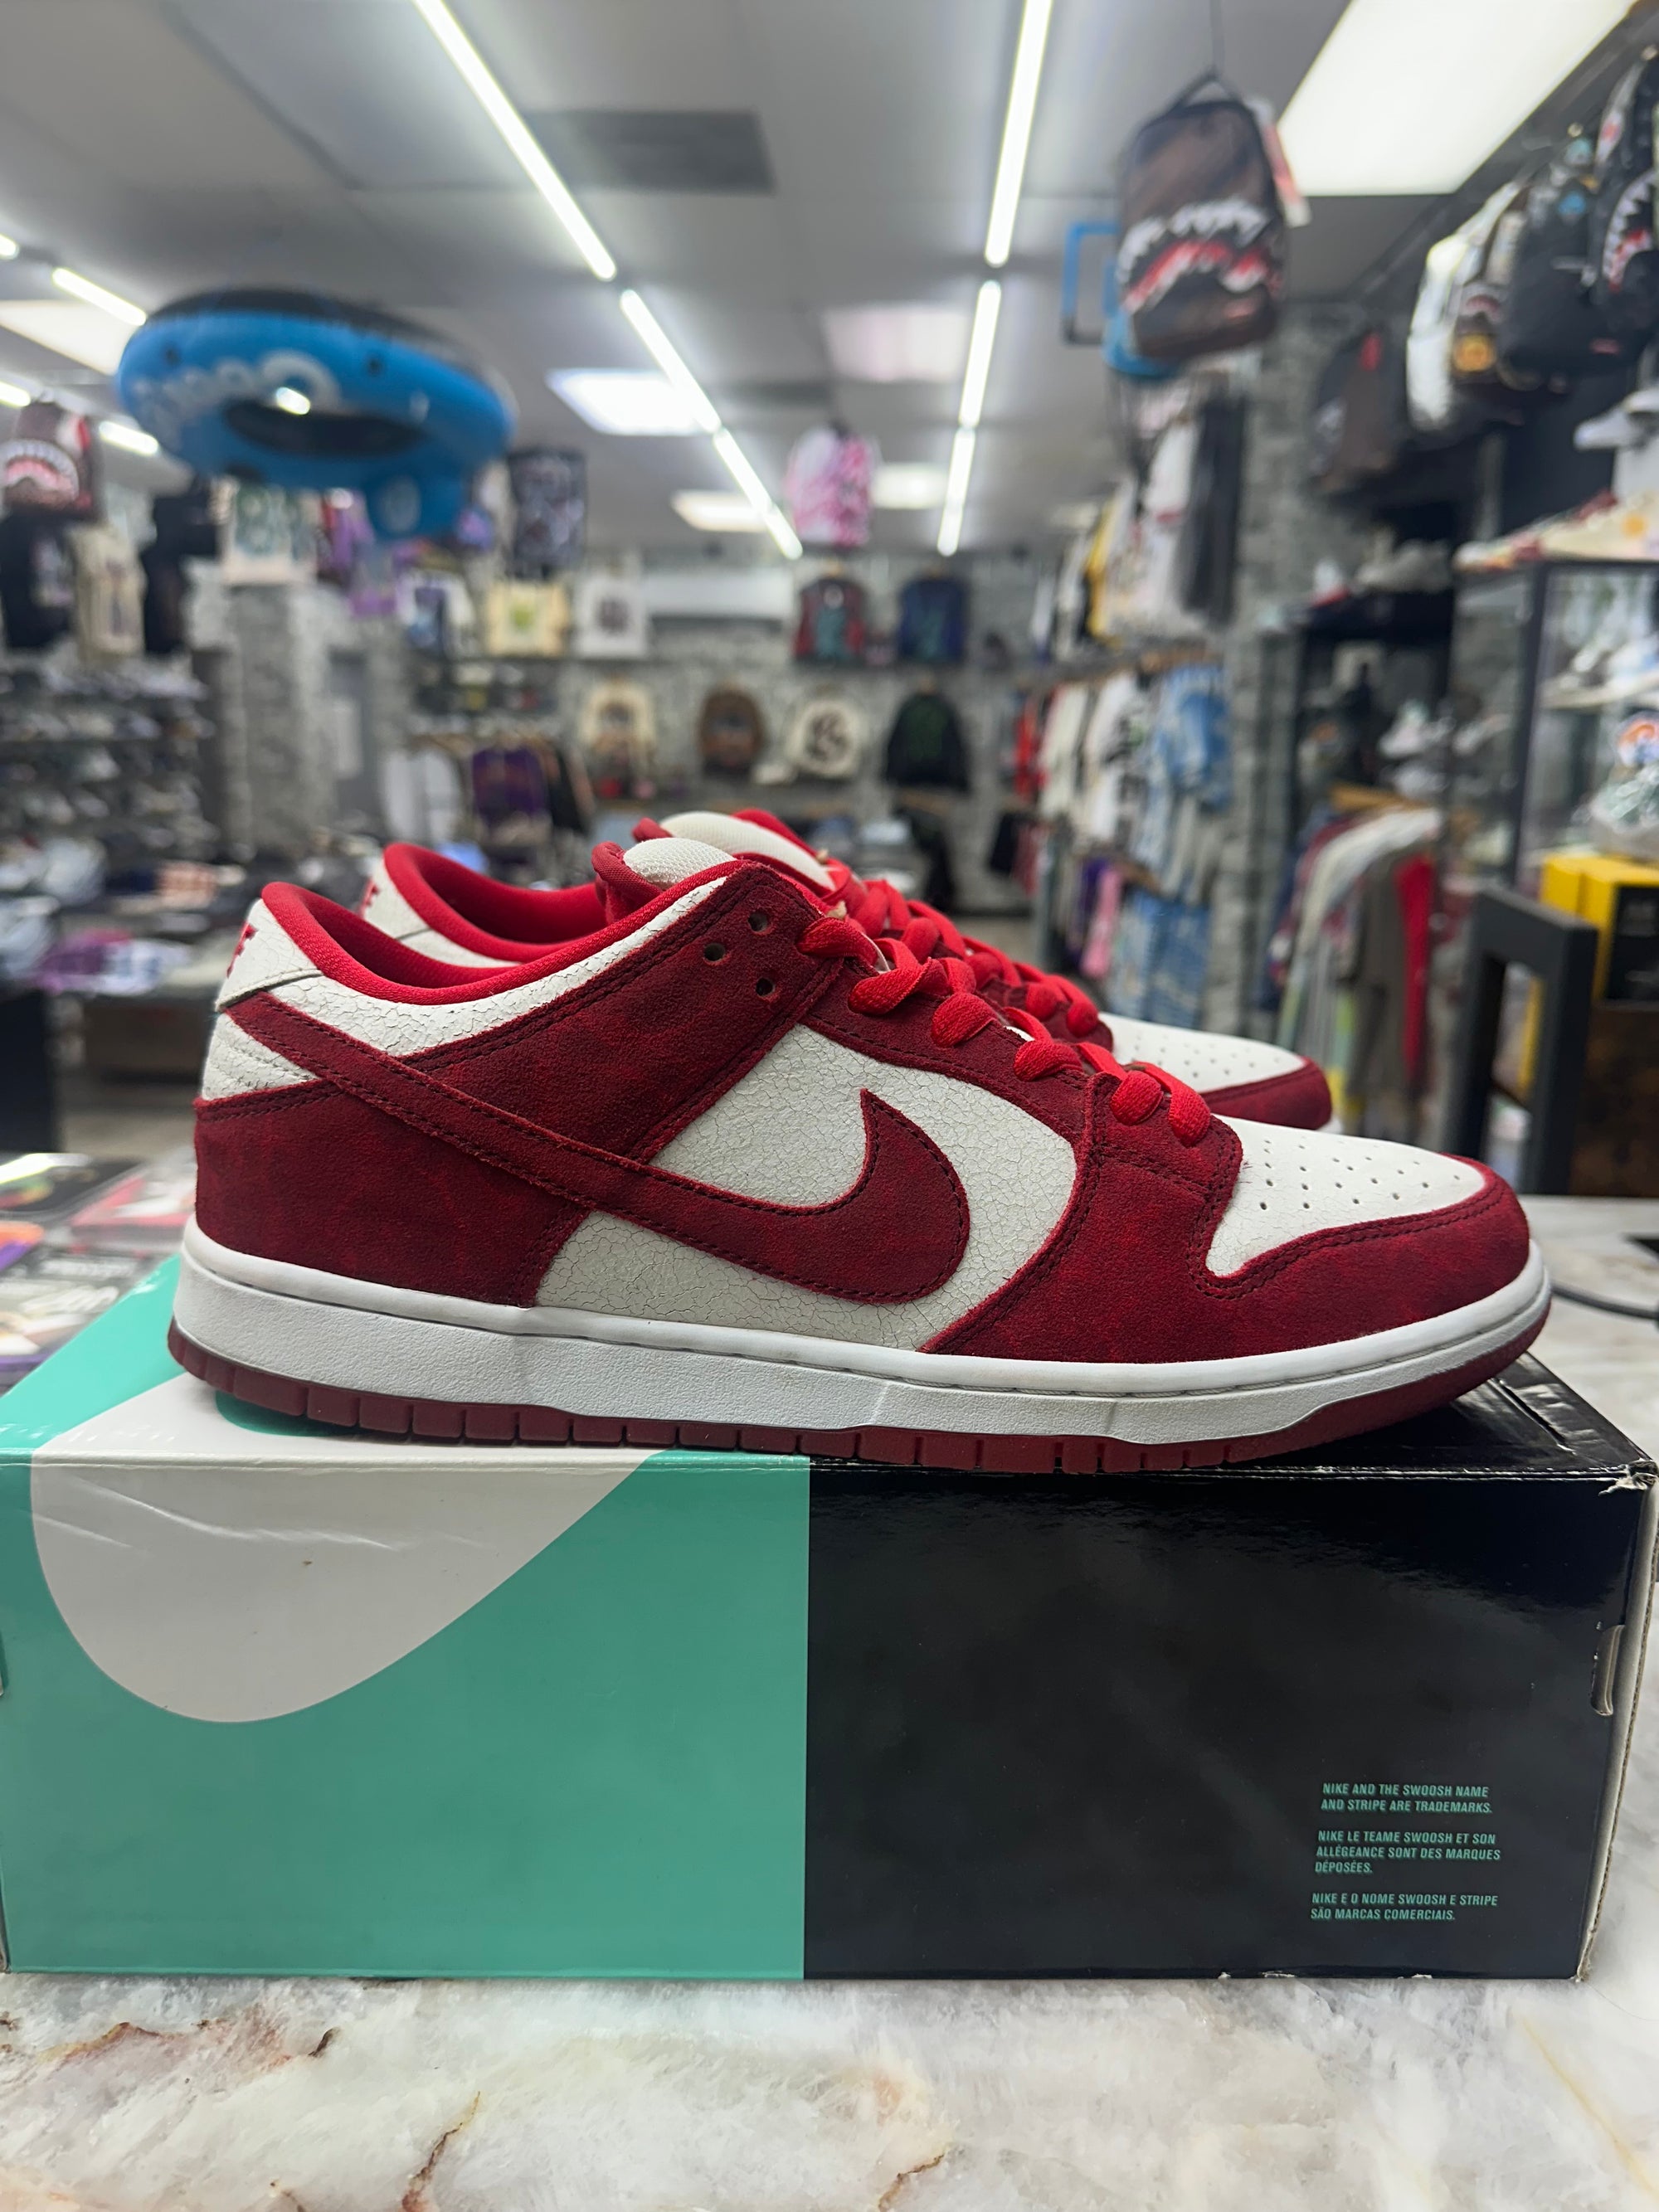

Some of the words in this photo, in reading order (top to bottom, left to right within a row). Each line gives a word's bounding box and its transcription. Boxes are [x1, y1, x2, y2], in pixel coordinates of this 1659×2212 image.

[1322, 1782, 1350, 1795] NIKE
[1352, 1783, 1375, 1795] AND
[1379, 1784, 1399, 1796] THE
[1403, 1784, 1452, 1796] SWOOSH
[1455, 1786, 1490, 1797] NAME
[1321, 1799, 1345, 1811] AND
[1347, 1799, 1387, 1811] STRIPE
[1389, 1800, 1411, 1811] ARE
[1414, 1801, 1492, 1813] TRADEMARKS.
[1318, 1830, 1344, 1841] NIKE
[1347, 1830, 1360, 1841] LE
[1363, 1830, 1401, 1842] TEAME
[1404, 1831, 1453, 1843] SWOOSH
[1456, 1833, 1470, 1844] ET
[1472, 1833, 1496, 1845] SON
[1316, 1844, 1385, 1858] ALLÉGEANCE
[1388, 1846, 1418, 1858] SONT
[1420, 1847, 1443, 1859] DES
[1445, 1848, 1501, 1860] MARQUES
[1315, 1860, 1373, 1873] DÉPOSÉES.
[1311, 1893, 1338, 1903] NIKE
[1340, 1893, 1348, 1903] E
[1350, 1893, 1359, 1904] O
[1361, 1893, 1395, 1904] NOME
[1398, 1894, 1447, 1905] SWOOSH
[1449, 1894, 1457, 1905] E
[1459, 1894, 1498, 1906] STRIPE
[1311, 1906, 1332, 1919] SÃO
[1335, 1908, 1381, 1919] MARCAS
[1384, 1908, 1456, 1921] COMERCIAIS.
